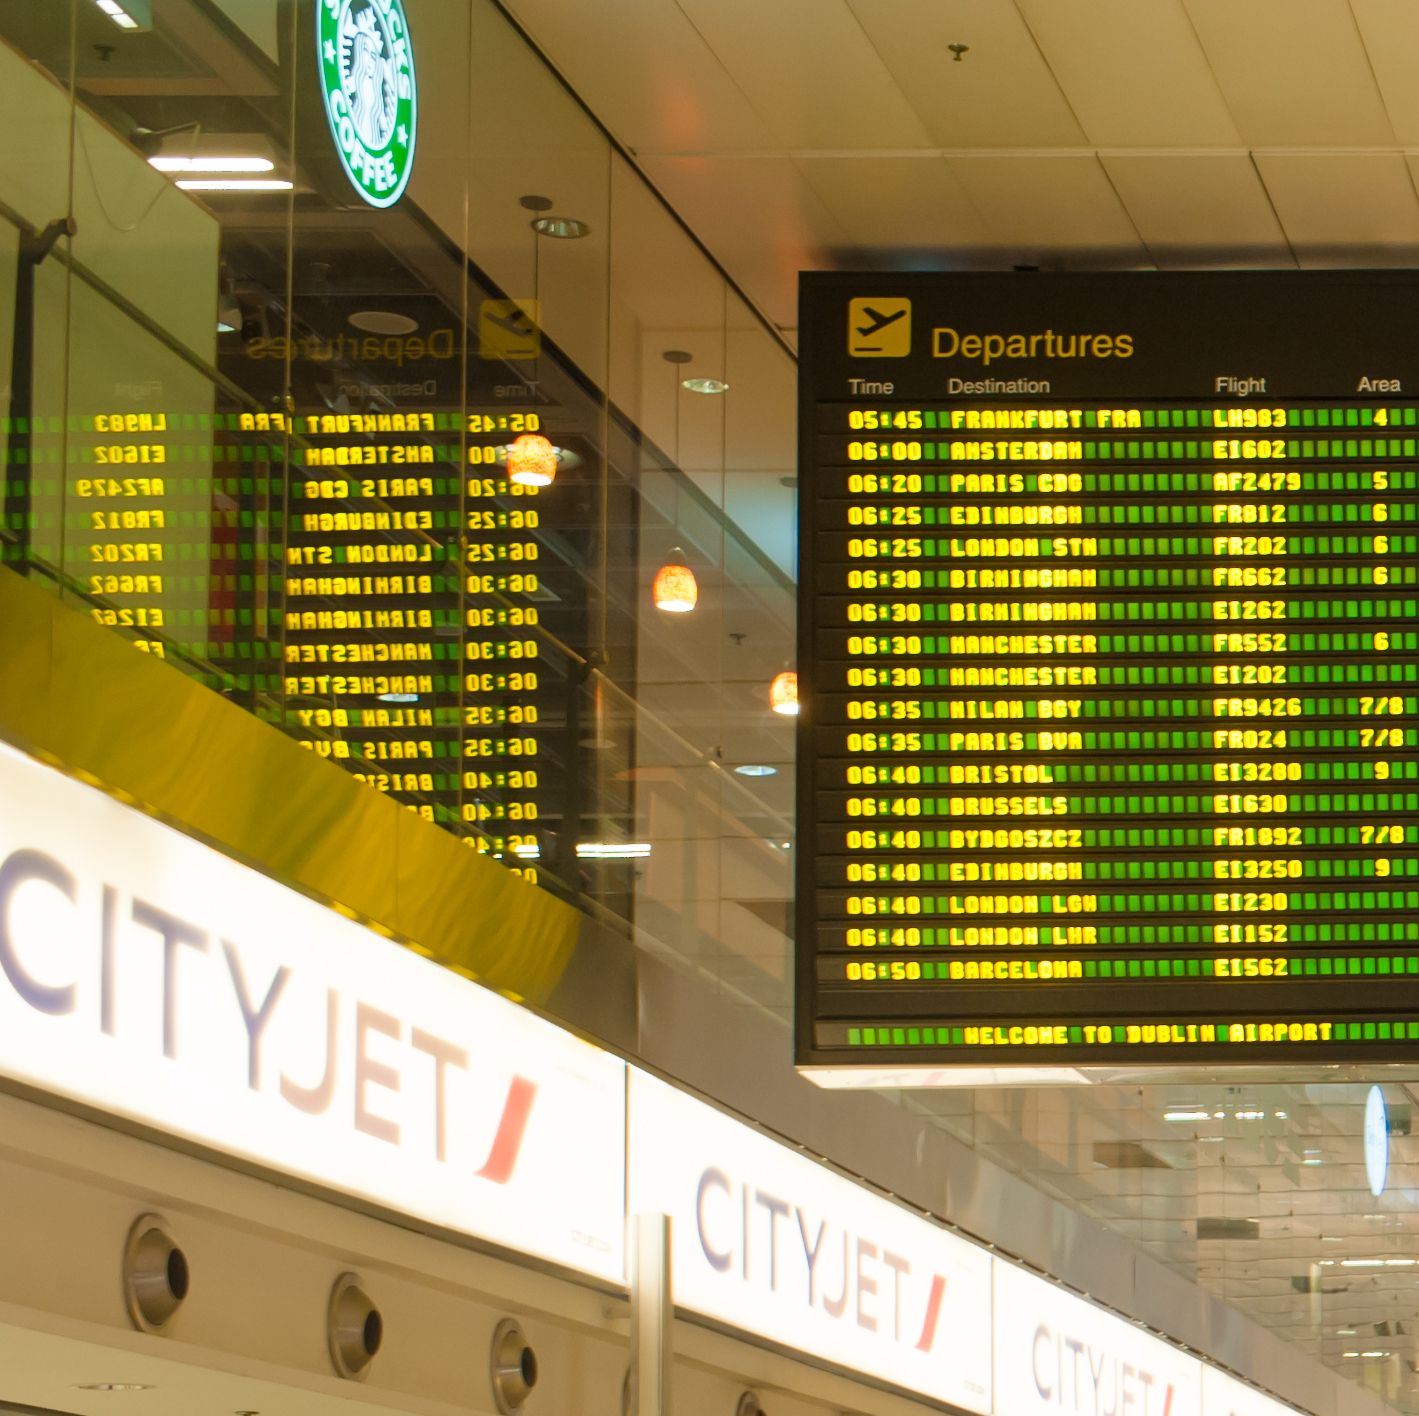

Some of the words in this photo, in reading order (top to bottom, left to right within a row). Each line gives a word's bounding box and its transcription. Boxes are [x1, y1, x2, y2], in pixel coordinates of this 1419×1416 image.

[329, 88, 398, 192] COFFEE
[932, 327, 1134, 364] Departures
[848, 379, 895, 395] Time
[948, 378, 1050, 395] Destination
[1216, 376, 1266, 395] Flight
[1358, 376, 1402, 392] Area
[848, 410, 923, 430] 05:45
[951, 409, 1083, 429] FRANKFURT
[1096, 409, 1142, 428] FRA
[1213, 408, 1287, 428] LH983
[1373, 408, 1388, 426] 4
[848, 474, 922, 493] 06:20
[950, 473, 1024, 493] PARIS
[1037, 473, 1083, 493] CDG
[1212, 472, 1301, 492] AF2479
[1373, 471, 1388, 490] 5
[847, 732, 921, 752] 06:35
[949, 732, 1024, 751] PARIS
[1037, 731, 1083, 751] BVA
[1213, 729, 1287, 749] FR024
[1360, 728, 1404, 747] 7/8
[0, 848, 469, 1163] CITYJET
[963, 1025, 1068, 1045] WELCOME
[1083, 1025, 1112, 1044] TO
[1126, 1024, 1215, 1044] DUBLIN
[1228, 1022, 1332, 1042] AIRPORT
[695, 1167, 911, 1342] CITYJET
